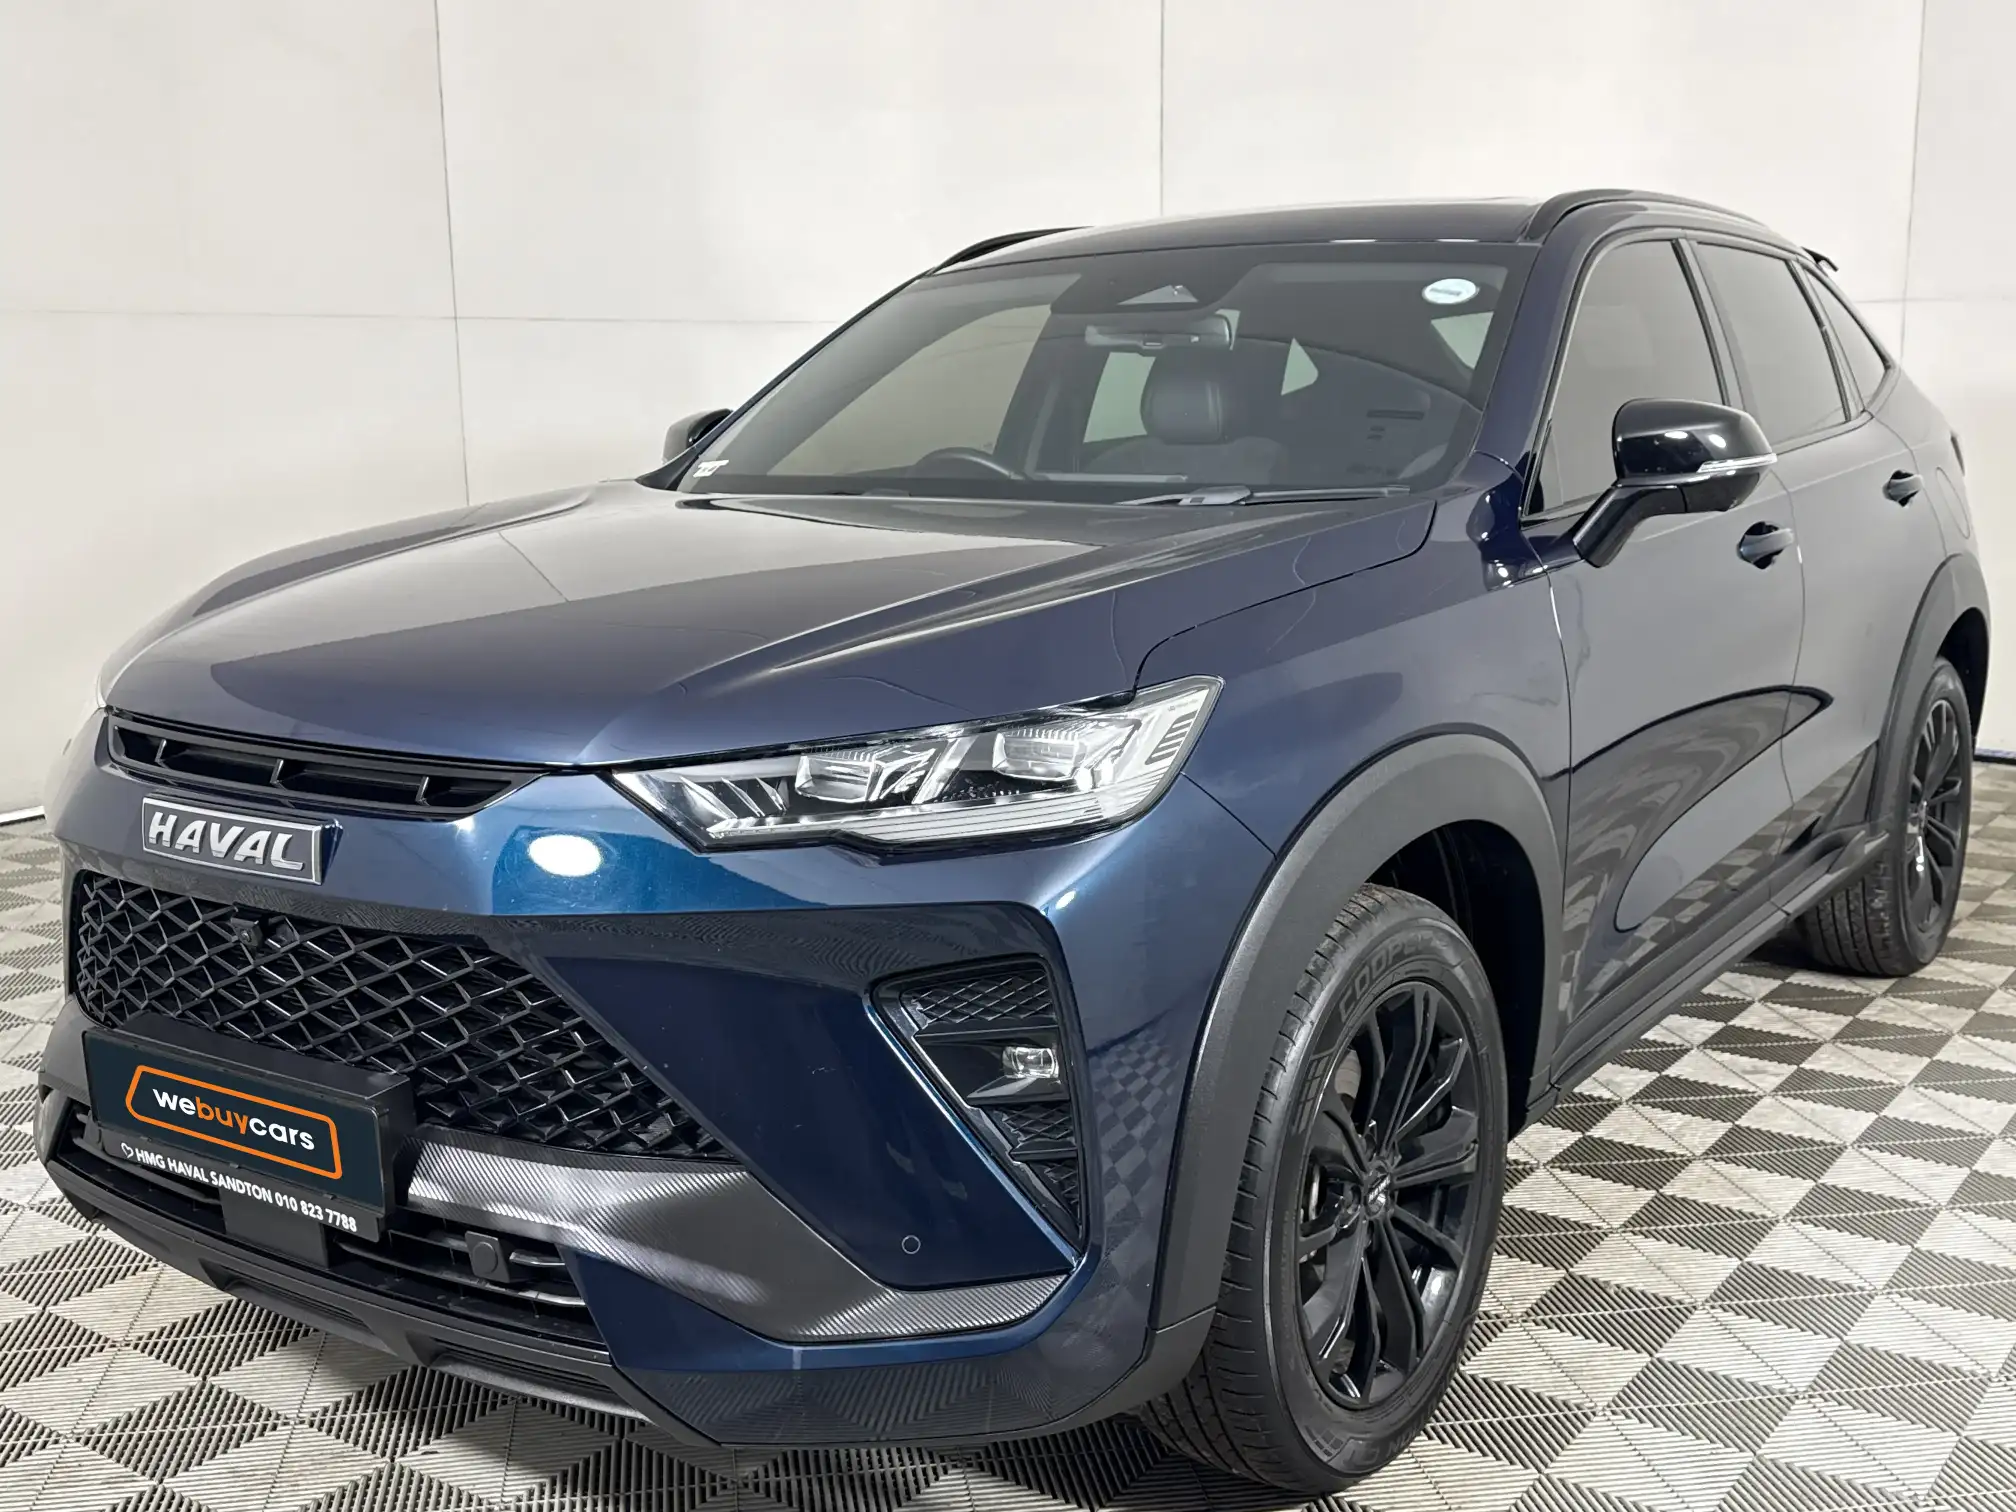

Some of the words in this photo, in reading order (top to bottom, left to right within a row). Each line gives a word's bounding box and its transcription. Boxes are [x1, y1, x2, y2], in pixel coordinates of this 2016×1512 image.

[149, 811, 304, 871] HAVAL
[152, 1088, 315, 1150] webuycars
[136, 1147, 166, 1168] HMG
[168, 1157, 210, 1183] HAVAL
[211, 1171, 273, 1204] SANDTON
[275, 1191, 298, 1212] 010
[301, 1200, 324, 1221] 823
[325, 1209, 357, 1232] 7788
